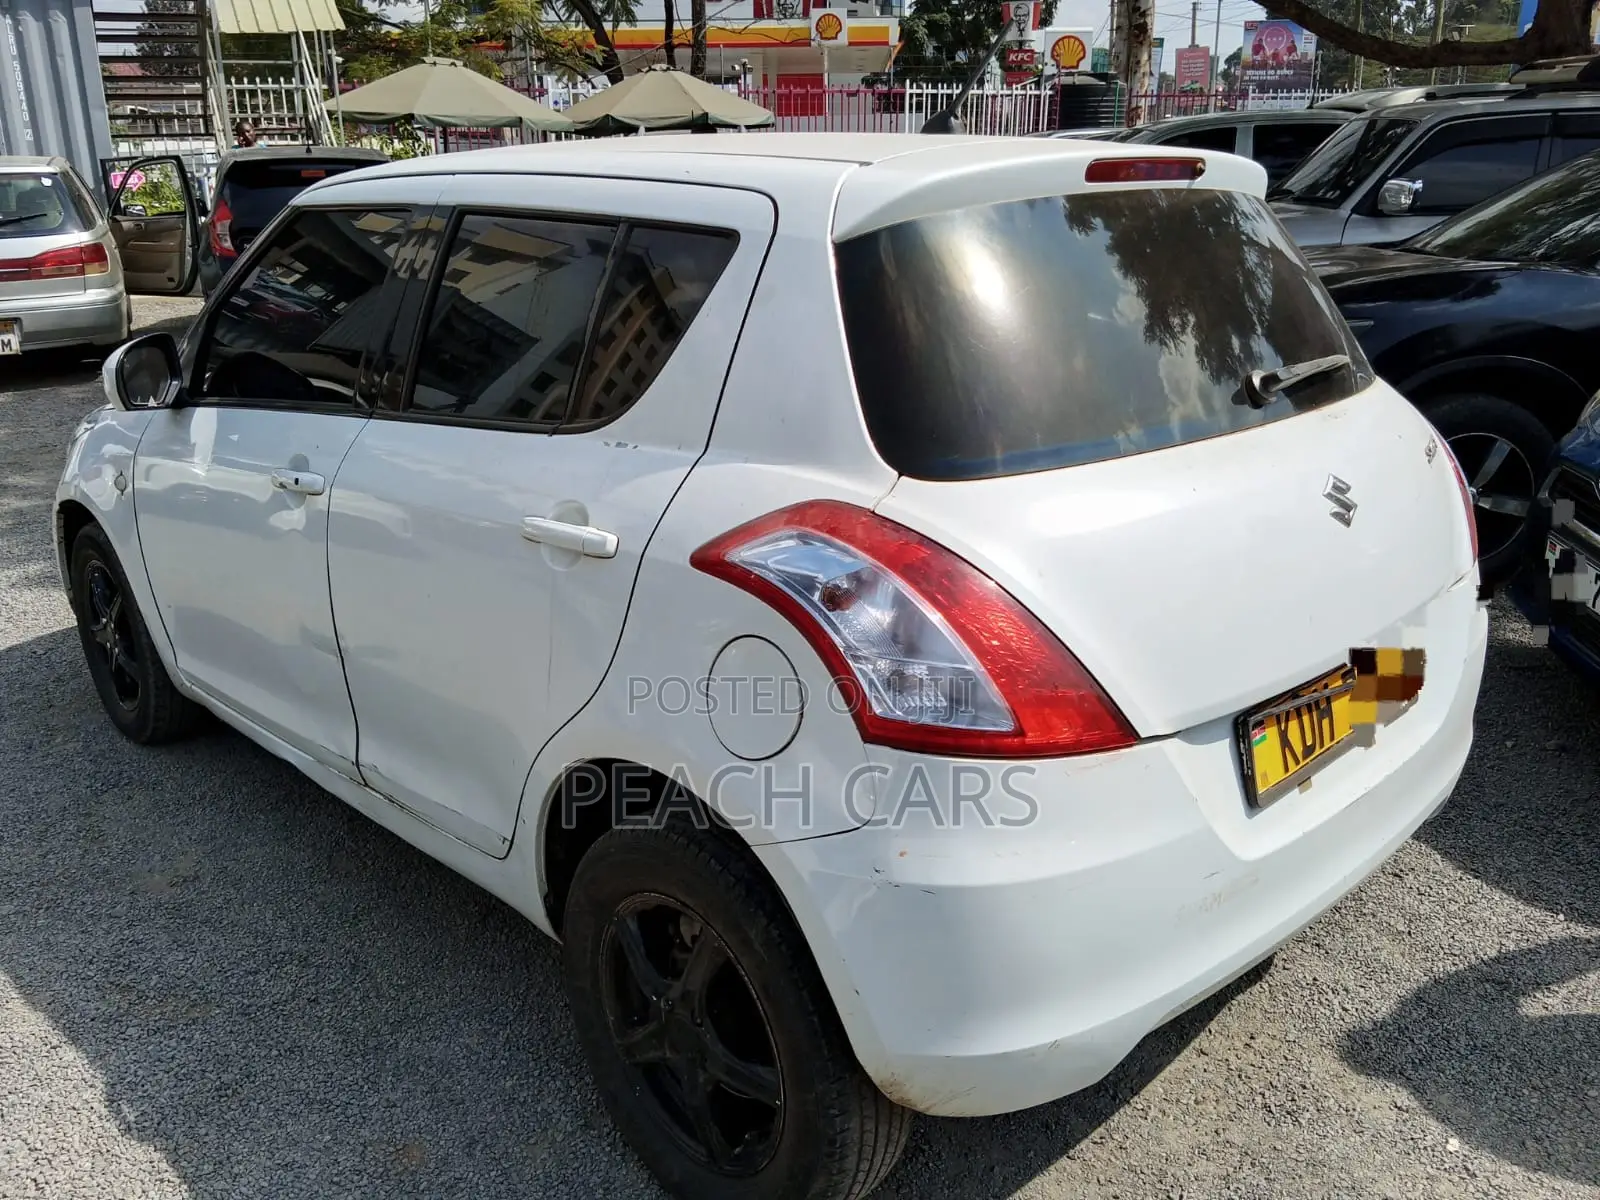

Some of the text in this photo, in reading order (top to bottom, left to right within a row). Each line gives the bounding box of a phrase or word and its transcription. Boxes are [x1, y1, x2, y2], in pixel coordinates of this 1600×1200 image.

[5, 13, 17, 56] ALRU
[12, 61, 30, 122] 509440
[1008, 52, 1032, 62] KFC
[1275, 696, 1336, 773] KDH
